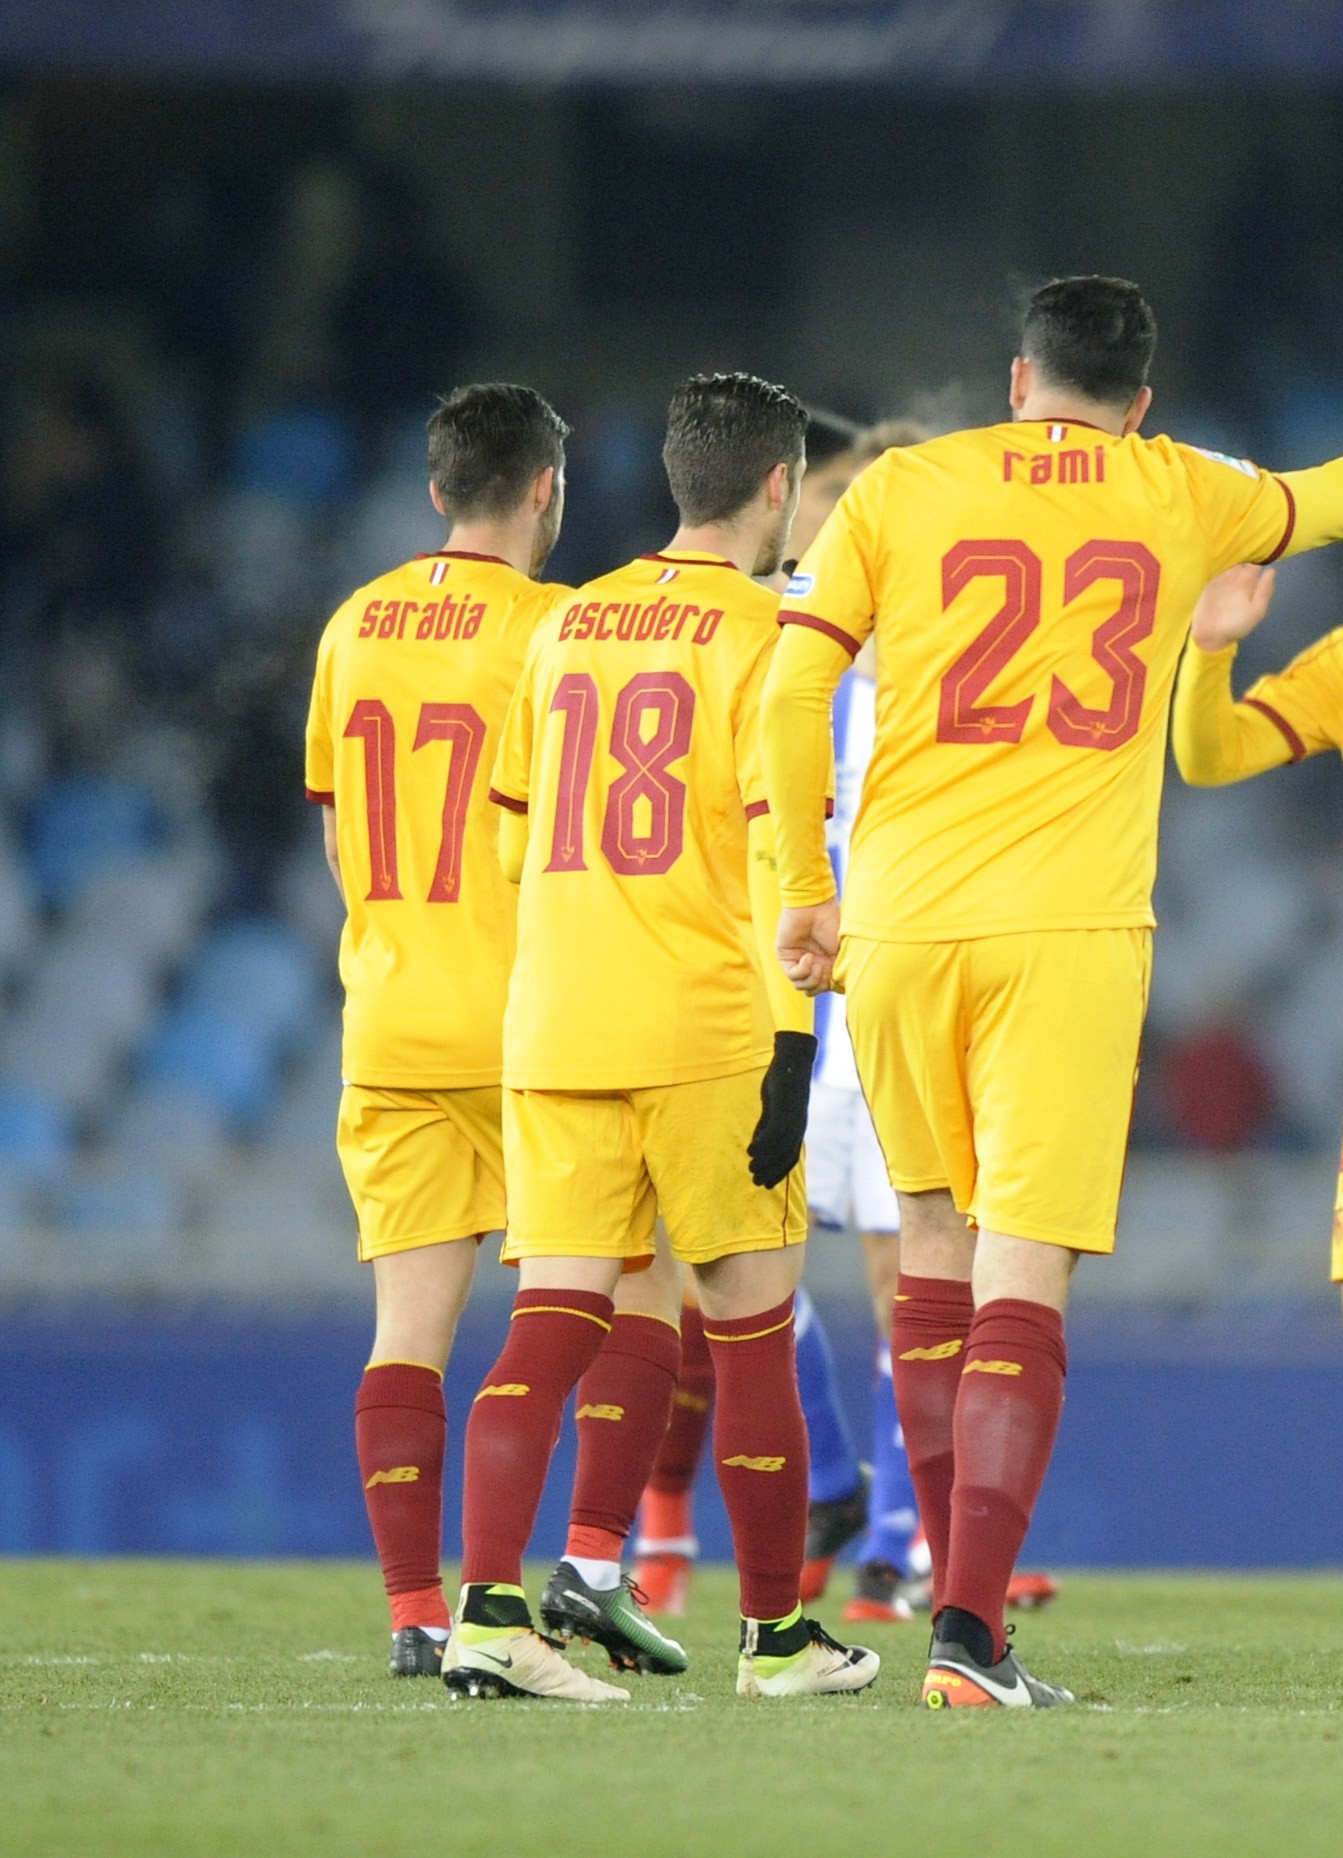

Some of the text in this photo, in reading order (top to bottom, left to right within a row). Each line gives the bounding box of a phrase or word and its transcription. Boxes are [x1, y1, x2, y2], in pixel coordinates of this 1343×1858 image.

[1003, 445, 1105, 485] rami
[358, 593, 487, 641] sarabia
[558, 595, 725, 646] escudero
[935, 539, 1162, 752] 23
[342, 699, 487, 904] 17
[542, 671, 696, 876] 18
